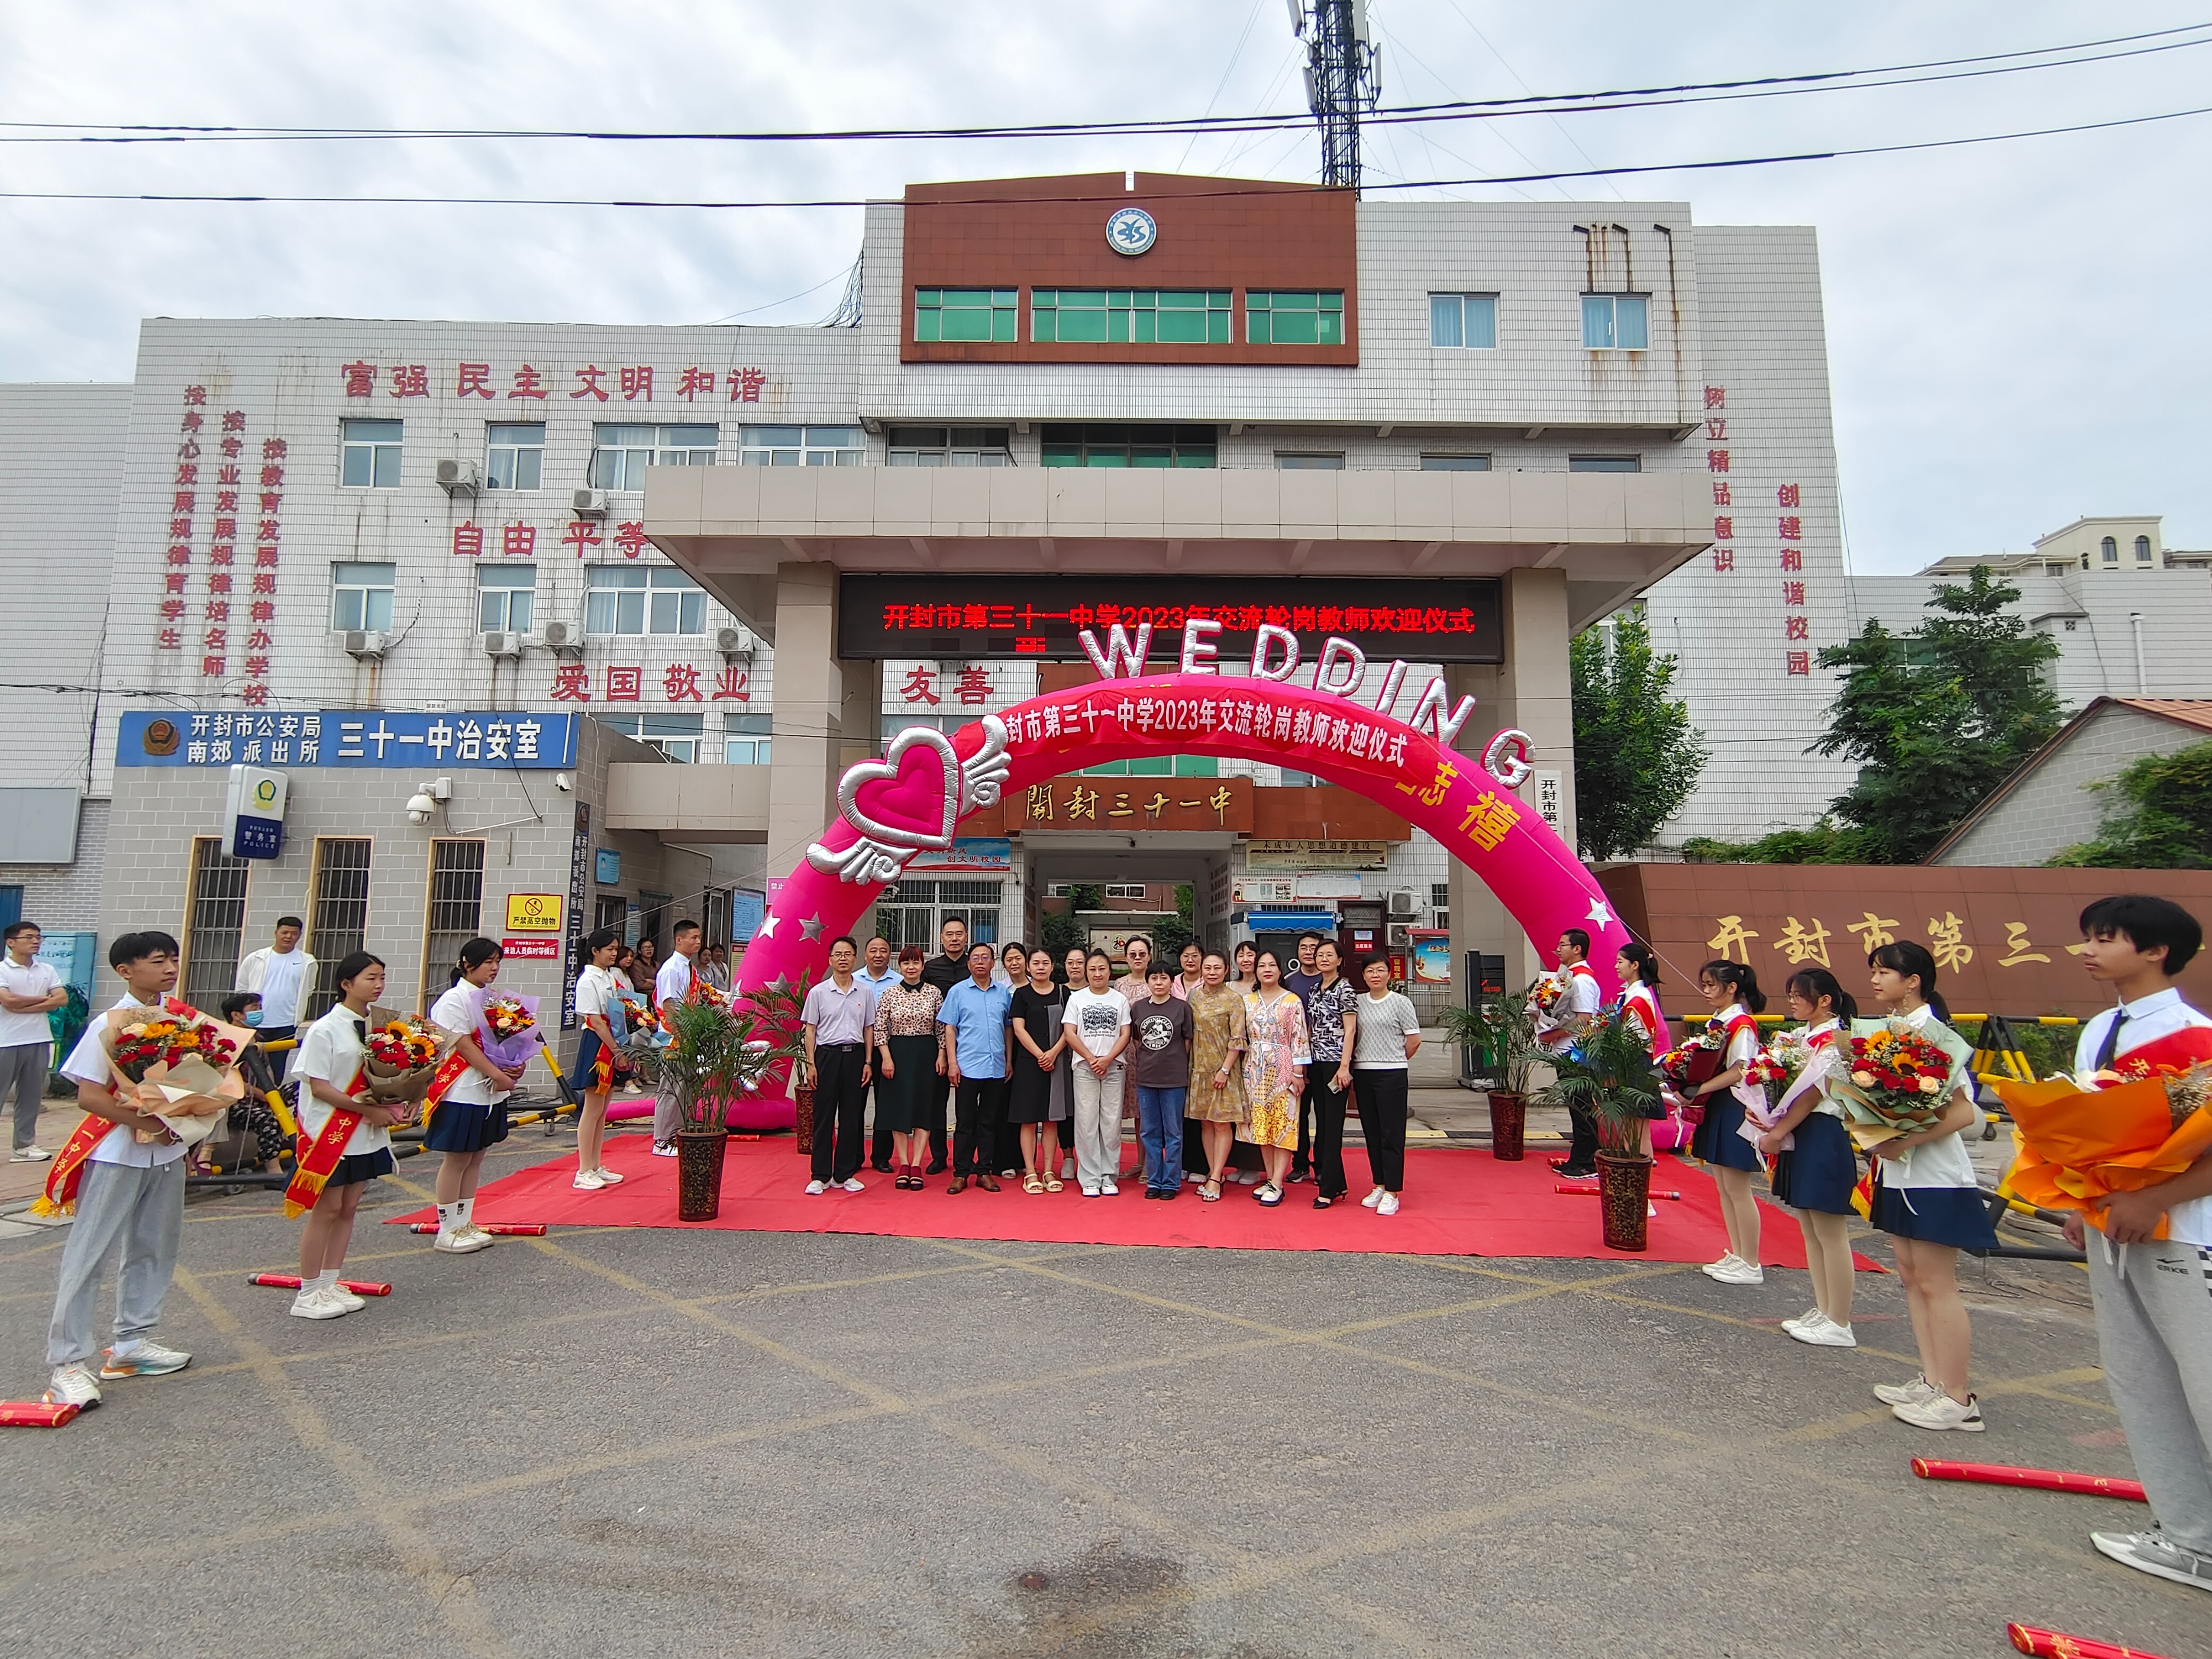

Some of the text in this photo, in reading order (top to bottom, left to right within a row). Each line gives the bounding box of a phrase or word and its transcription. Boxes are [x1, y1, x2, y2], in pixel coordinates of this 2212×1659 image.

[1704, 385, 1734, 572] 树立精品意识
[159, 385, 207, 650] 按身心发展规律育学生
[203, 411, 246, 678] 按专业发展规律培名师
[243, 438, 287, 707] 按教育发展规律办学校
[1777, 483, 1809, 676] 创建和谐校园
[883, 602, 1476, 634] 开封市第三十一中学2023年交流轮岗教师欢迎仪式
[551, 664, 751, 702] 爱国敬业
[900, 666, 994, 705] 友善
[1079, 618, 1536, 790] WEDDING
[190, 714, 322, 739] 开封市公安局
[338, 718, 541, 760] 三十一中治安室
[1002, 697, 1408, 768] 封市第三十一中学2023年交流轮岗教师欢迎仪式
[187, 740, 321, 764] 南郊派出所
[243, 840, 275, 849] POLICE
[512, 916, 556, 925] 严禁高空抛物
[503, 946, 556, 956] 来访人员临时等候区
[564, 915, 581, 1026] 三十一中治安室
[328, 1116, 353, 1145] 中学
[2156, 1264, 2191, 1275] ERKE
